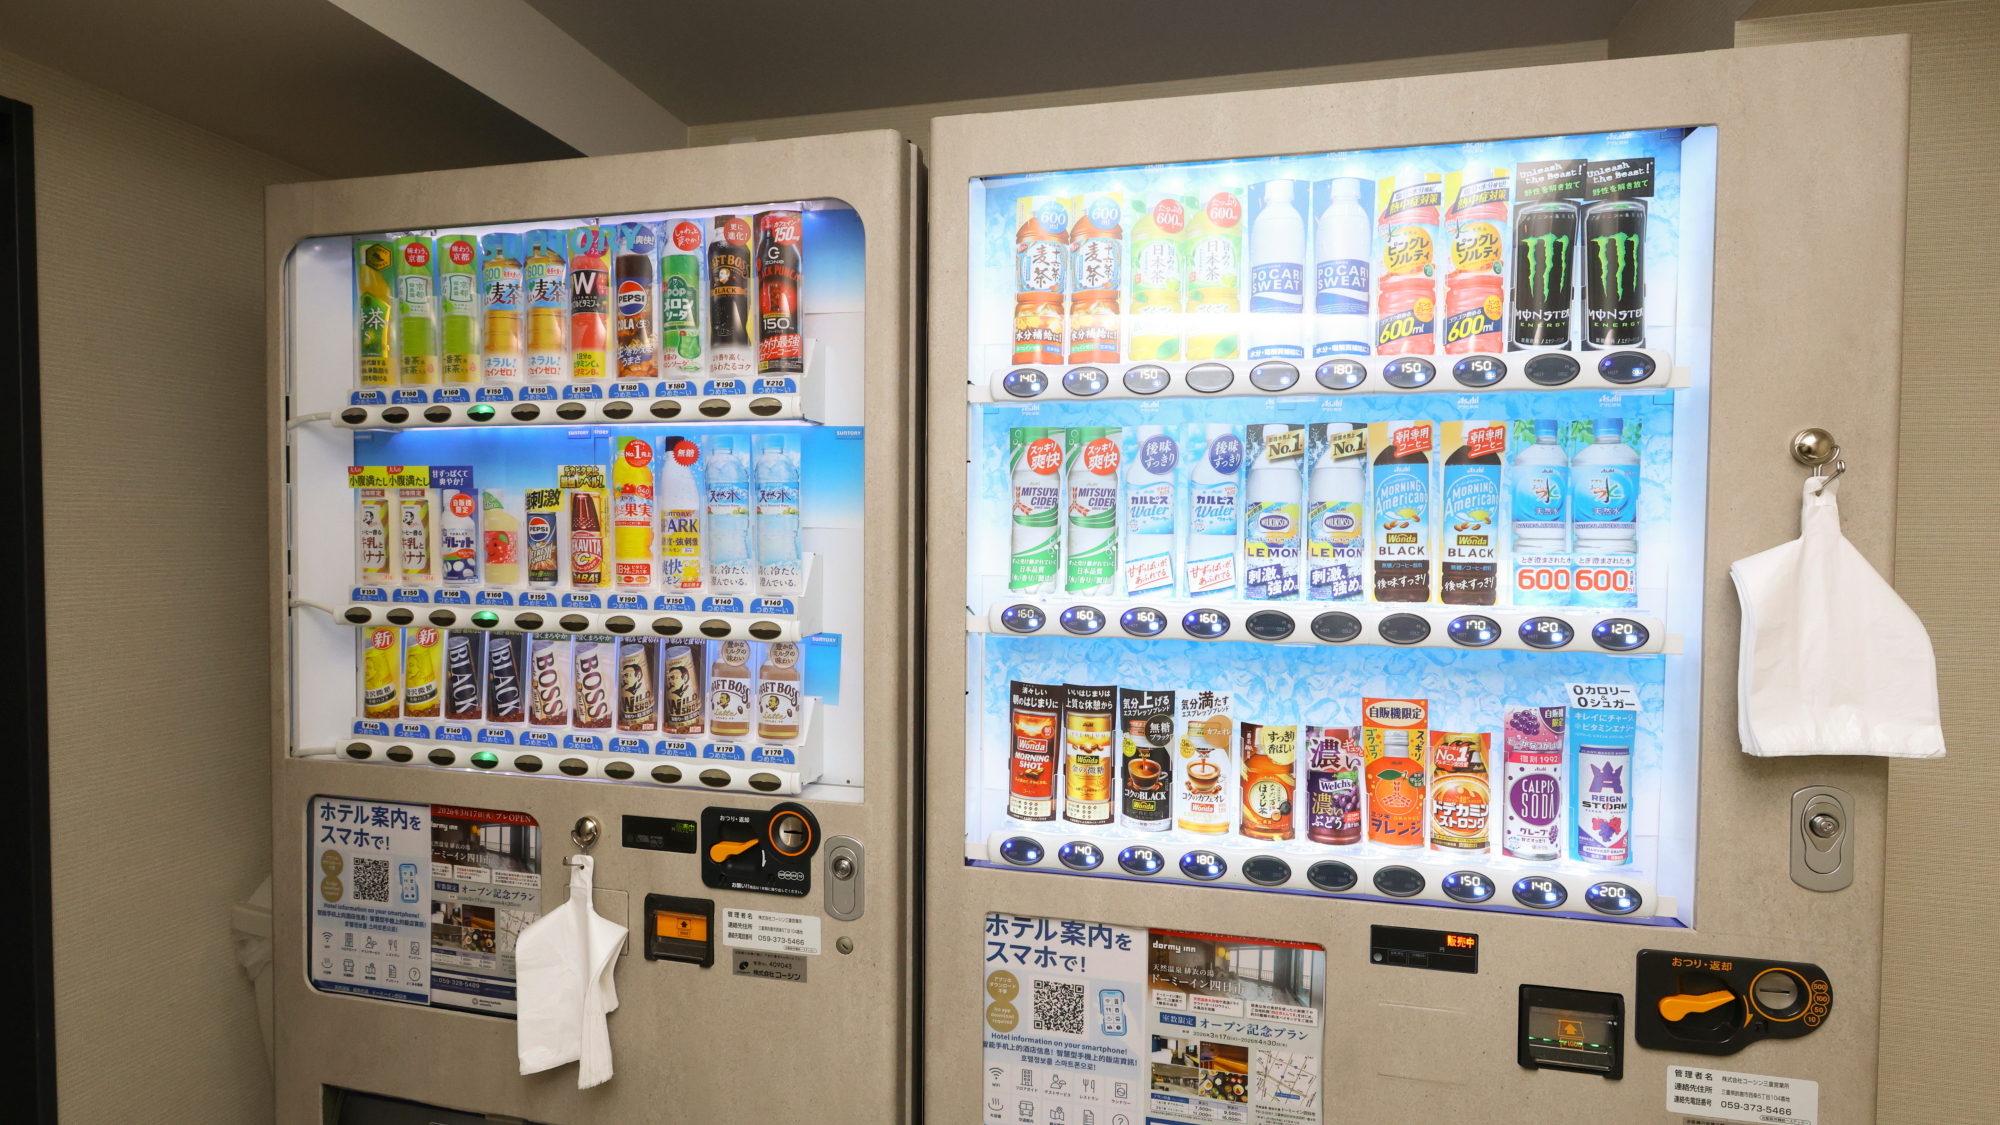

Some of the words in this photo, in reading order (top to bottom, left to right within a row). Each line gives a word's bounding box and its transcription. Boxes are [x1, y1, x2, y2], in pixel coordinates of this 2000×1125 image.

[1520, 163, 1562, 179] Unleash
[1526, 176, 1545, 184] the
[1547, 165, 1582, 180] Beast!
[1587, 162, 1630, 177] Unleash
[1593, 175, 1612, 183] the
[1615, 163, 1650, 179] Beast!
[1593, 180, 1648, 195] 野性を解き放て
[1457, 190, 1507, 210] 熱中症対策
[1091, 208, 1118, 220] 600
[1388, 237, 1429, 256] ピングレ
[408, 255, 425, 263] 京都
[452, 253, 470, 261] 京都
[1390, 251, 1429, 267] ソルティ
[1252, 269, 1302, 282] POCARI
[573, 271, 596, 294] W
[1252, 280, 1300, 292] SWEAT
[1318, 277, 1366, 290] SWEAT
[618, 295, 645, 303] PEPSI
[1334, 365, 1352, 374] 180
[1402, 364, 1421, 373] 150
[1019, 374, 1036, 382] 140
[1080, 371, 1096, 380] 140
[1140, 370, 1157, 379] 150
[1322, 399, 1342, 407] Asahi
[1396, 429, 1429, 443] 朝専用
[1030, 443, 1056, 455] スッキリ
[1146, 442, 1172, 454] 後味
[1400, 441, 1428, 450] コーヒー
[1474, 442, 1503, 450] コーヒー
[677, 449, 694, 458] 無糖
[1032, 455, 1059, 470] 爽快
[1146, 454, 1174, 468] すっきり
[432, 470, 468, 478] 甘ずっぱくて
[638, 486, 649, 495] 540
[1022, 487, 1058, 497] MITSUYA
[1079, 487, 1115, 497] MITSUYA
[1381, 482, 1421, 497] MORNING
[1453, 482, 1494, 498] MORNING
[1031, 497, 1058, 506] CIDER
[1088, 498, 1115, 507] CIDER
[1131, 496, 1168, 505] カルピス
[1197, 496, 1234, 505] カルピス
[1130, 506, 1168, 518] Water
[1594, 507, 1620, 515] 天然水
[1388, 534, 1417, 544] Wonda
[1459, 537, 1487, 545] Wonda
[1379, 547, 1424, 556] BLACK
[1448, 549, 1493, 558] BLACK
[1579, 557, 1632, 565] とぎ澄まされた水
[1249, 566, 1280, 584] 刺激、
[1378, 574, 1426, 589] 後味すっきり
[1018, 610, 1034, 618] 160
[1077, 611, 1093, 620] 160
[1138, 613, 1155, 621] 160
[1200, 614, 1217, 623] 160
[1466, 621, 1486, 629] 170
[1538, 623, 1558, 632] 120
[1611, 625, 1632, 634] 120
[374, 630, 392, 648] 新
[419, 628, 437, 646] 新
[537, 652, 561, 718] BOSS
[1573, 685, 1630, 695] 0カロリー
[1066, 699, 1113, 709] 上質な休憩から
[1123, 692, 1169, 709] 気分上げる
[1182, 692, 1229, 710] 気分満たす
[1578, 697, 1635, 708] 0シュガー
[714, 708, 737, 717] Latte
[1370, 707, 1422, 719] 自販機限定
[1150, 723, 1170, 733] 無糖
[1552, 719, 1563, 727] 限定
[1019, 740, 1045, 750] Wonda
[1015, 752, 1049, 762] MORNING
[1078, 755, 1098, 763] Wonda
[1520, 755, 1537, 763] 復刻
[1522, 779, 1554, 793] CALPIS
[1125, 789, 1166, 800] コクのBLACK
[1434, 802, 1489, 817] ドデカミン
[1522, 794, 1555, 819] SODA
[320, 803, 421, 830] ホテル案内を
[720, 815, 749, 823] おつり・返却
[1312, 816, 1342, 830] ぶどう
[1438, 816, 1484, 828] ストロング
[1520, 827, 1548, 836] グレープ
[321, 825, 390, 850] スマホで!
[1075, 847, 1091, 855] 140
[1135, 851, 1152, 860] 170
[1197, 856, 1214, 865] 180
[1600, 886, 1625, 897] 200
[338, 904, 367, 912] information
[388, 910, 419, 918] smartphone!
[1447, 935, 1475, 948] 販売中
[1153, 941, 1180, 953] dormy
[986, 941, 1086, 972] スマホで!
[1672, 958, 1733, 971] おつり・返却
[1152, 974, 1245, 994] ドーミーイン四日市
[991, 1032, 1010, 1040] Hotel
[1011, 1034, 1052, 1045] information
[1065, 1041, 1080, 1049] your
[1082, 1043, 1127, 1055] smartphone!
[1674, 1095, 1712, 1107] 連絡先電話番号
[1721, 1101, 1792, 1115] 059-373-5466
